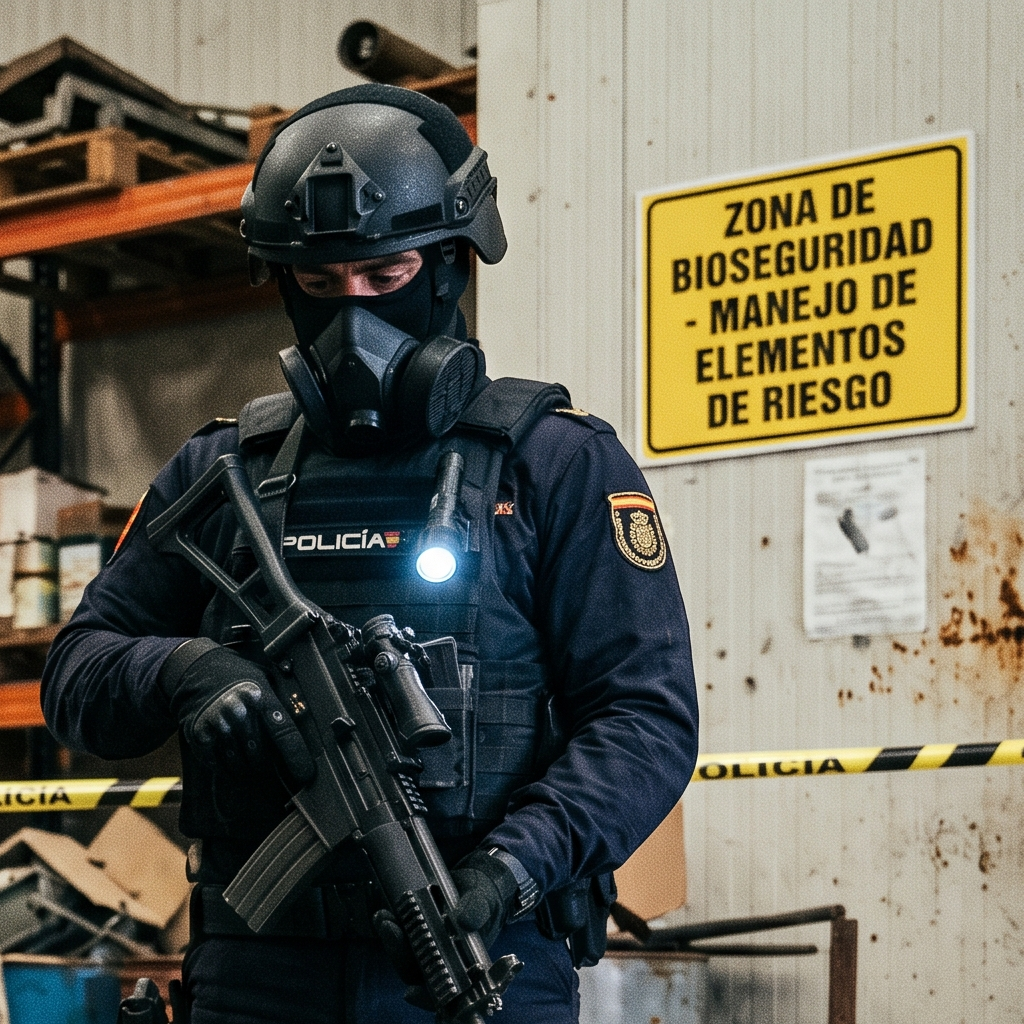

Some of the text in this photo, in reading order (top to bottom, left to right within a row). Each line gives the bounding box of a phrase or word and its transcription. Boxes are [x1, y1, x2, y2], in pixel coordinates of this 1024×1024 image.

[724, 177, 876, 239] ZONA DE
[672, 217, 933, 294] BIOSEGURIDAD
[710, 278, 857, 335] MANEJO
[872, 268, 917, 311] DE
[696, 319, 906, 384] ELEMENTOS
[707, 370, 892, 429] DE RIESGO
[283, 528, 386, 551] POLICÍA
[698, 757, 846, 780] OLICIA
